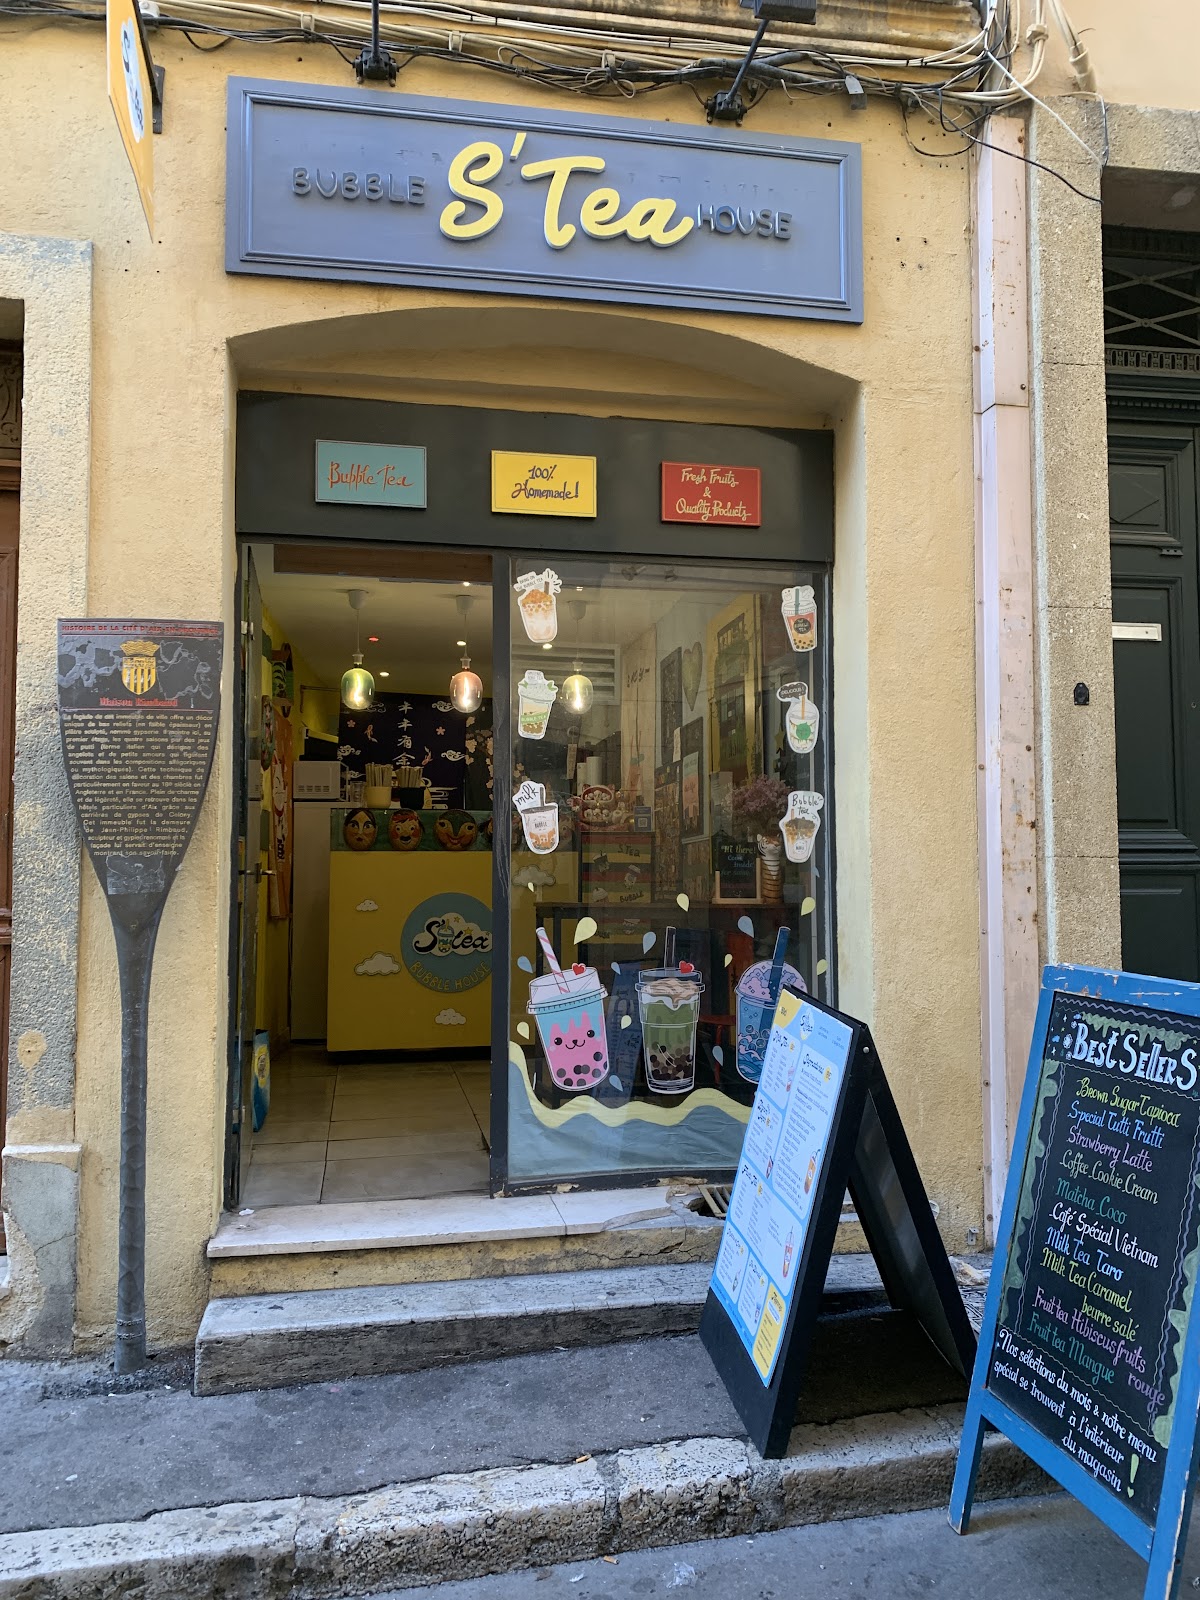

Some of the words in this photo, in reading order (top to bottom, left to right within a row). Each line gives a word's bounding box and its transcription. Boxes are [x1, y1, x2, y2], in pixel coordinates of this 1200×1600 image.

[291, 166, 426, 205] BUBBLE
[439, 132, 695, 251] S'Tea
[696, 203, 793, 240] HOUSE
[328, 461, 378, 492] Bubble
[377, 464, 414, 492] Tea
[511, 479, 579, 501] Homemade!
[528, 464, 558, 481] 100%
[681, 467, 707, 485] Fresh
[709, 468, 739, 488] Fruits
[703, 486, 712, 498] &
[675, 497, 712, 521] Quality
[712, 500, 752, 521] Products
[122, 624, 137, 632] CITÉ
[515, 783, 539, 806] milk
[792, 793, 819, 807] Bubble
[409, 961, 450, 991] BUBBLE
[455, 960, 491, 990] HOUSE
[1067, 1100, 1106, 1129] Special
[1107, 1110, 1132, 1137] Tutti
[1132, 1119, 1166, 1149] Frutti
[1076, 1076, 1109, 1103] Brown
[1109, 1085, 1140, 1117] Sugar
[1139, 1094, 1182, 1129] Tapioca
[1066, 1125, 1122, 1169] Strawberry
[1122, 1141, 1153, 1172] Latte
[1055, 1177, 1095, 1212] Matcha
[1095, 1195, 1128, 1225] Coco
[1059, 1149, 1090, 1179] Coffee
[1088, 1160, 1123, 1189] Cookie
[1121, 1172, 1159, 1205] Cream
[1044, 1226, 1070, 1256] Milk
[1073, 1237, 1091, 1266] Tea
[1096, 1249, 1125, 1282] Taro
[1048, 1201, 1076, 1233] Café
[1075, 1212, 1114, 1247] Spécial
[1114, 1229, 1159, 1269] Vietnam
[1039, 1247, 1066, 1277] Milk
[1068, 1260, 1087, 1289] Tea
[1087, 1271, 1133, 1313] Caramel
[1031, 1285, 1056, 1315] Fruit
[1056, 1300, 1069, 1325] tea
[1070, 1308, 1119, 1354] Hibiscus
[1112, 1340, 1147, 1374] fruits
[1080, 1295, 1112, 1328] beurre
[1112, 1317, 1140, 1343] salé
[1026, 1311, 1051, 1344] Fruit
[1051, 1329, 1066, 1353] tea
[1068, 1336, 1116, 1385] Mangue
[993, 1360, 1018, 1384] spécial
[1019, 1376, 1029, 1391] se
[1030, 1381, 1066, 1419] trouvent
[1067, 1410, 1077, 1428] à
[1076, 1415, 1125, 1465] l'intérieur
[996, 1329, 1019, 1357] Nos
[1018, 1348, 1056, 1385] sélections
[1056, 1370, 1069, 1394] du
[1069, 1385, 1093, 1412] mois
[1093, 1404, 1100, 1417] &
[1101, 1410, 1126, 1440] notre
[1128, 1430, 1158, 1463] menu
[1127, 1372, 1166, 1413] rouge
[1061, 1429, 1077, 1454] du
[1077, 1447, 1123, 1493] magasin
